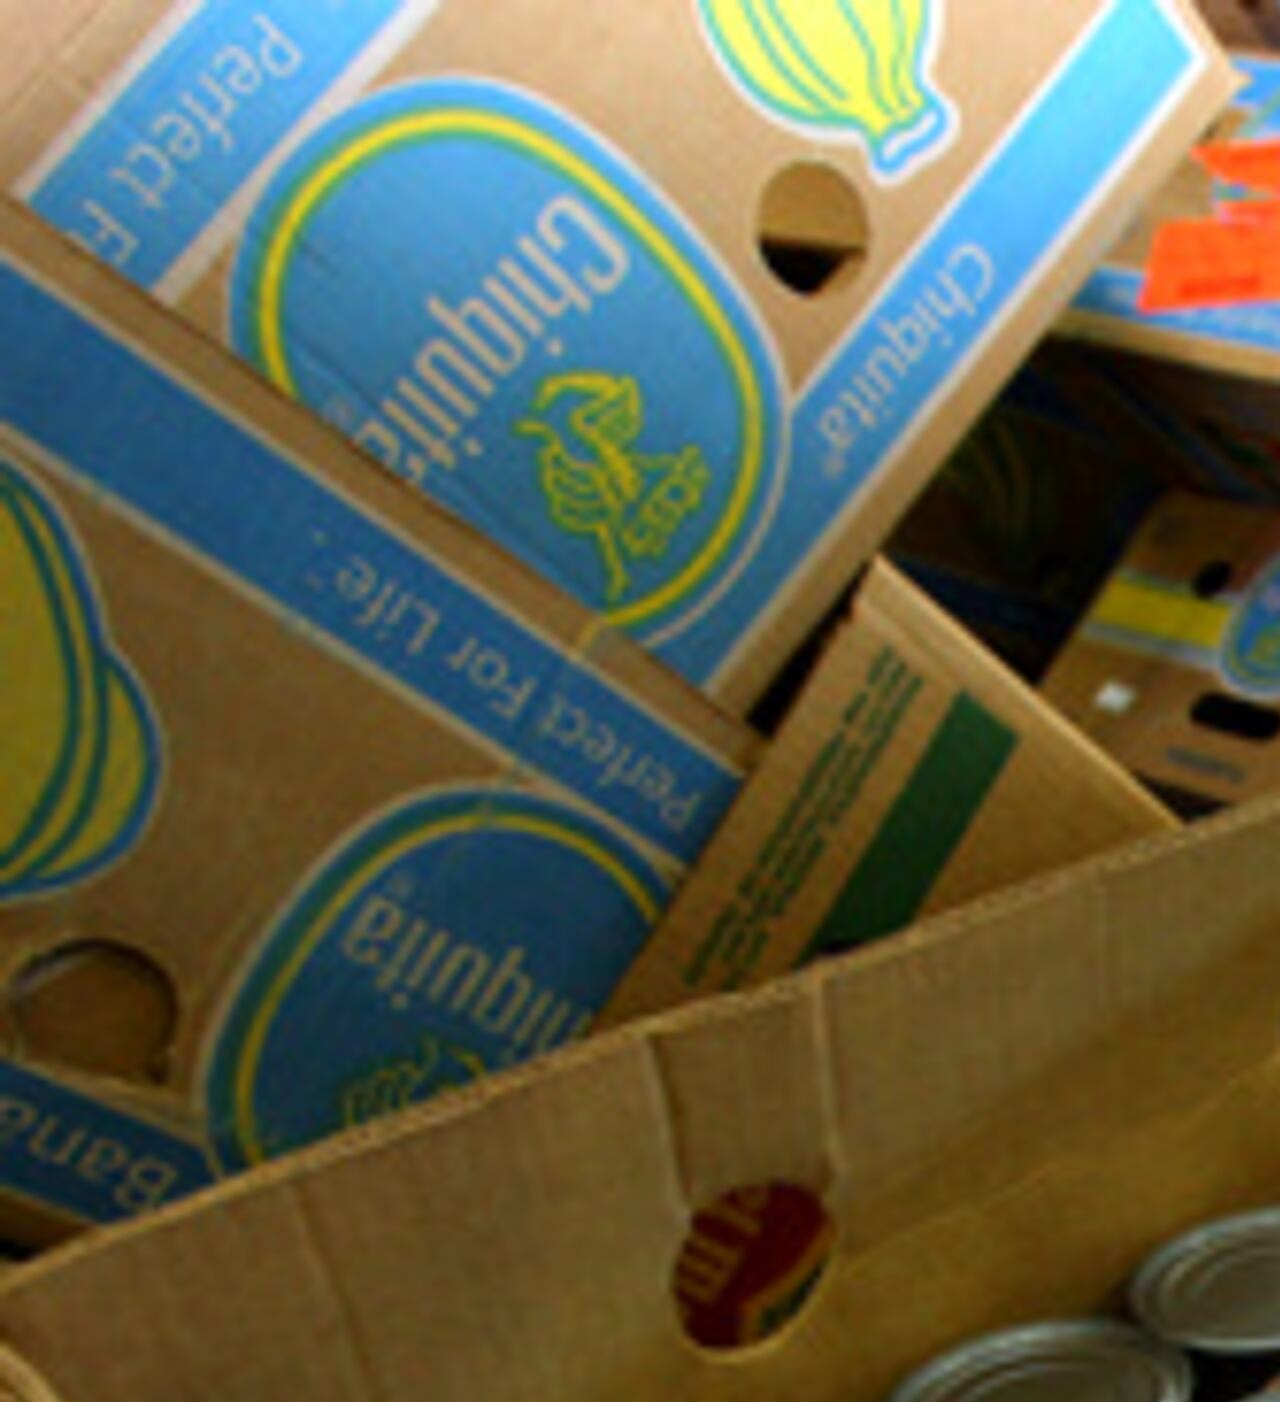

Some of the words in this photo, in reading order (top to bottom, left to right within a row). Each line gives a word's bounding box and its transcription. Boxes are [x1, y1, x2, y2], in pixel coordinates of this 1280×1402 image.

[110, 13, 302, 208] Perfect
[446, 637, 538, 720] For
[539, 693, 702, 831] Perfect
